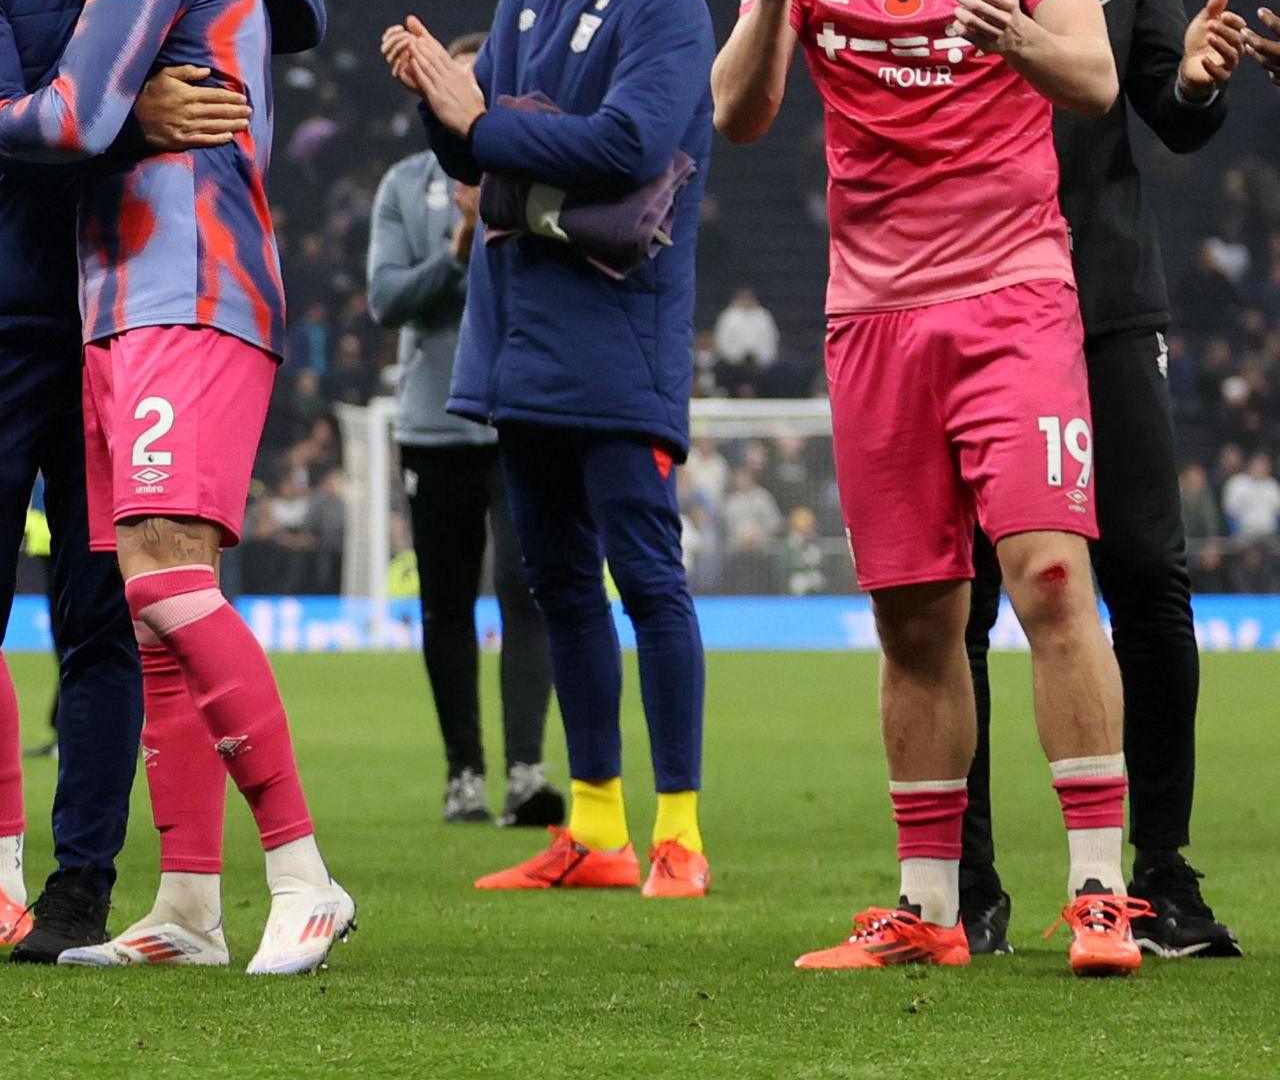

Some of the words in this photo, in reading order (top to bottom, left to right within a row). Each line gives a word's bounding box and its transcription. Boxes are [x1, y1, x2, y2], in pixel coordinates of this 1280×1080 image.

[878, 65, 953, 88] TOUR
[132, 396, 174, 466] 2
[1037, 416, 1093, 488] 19
